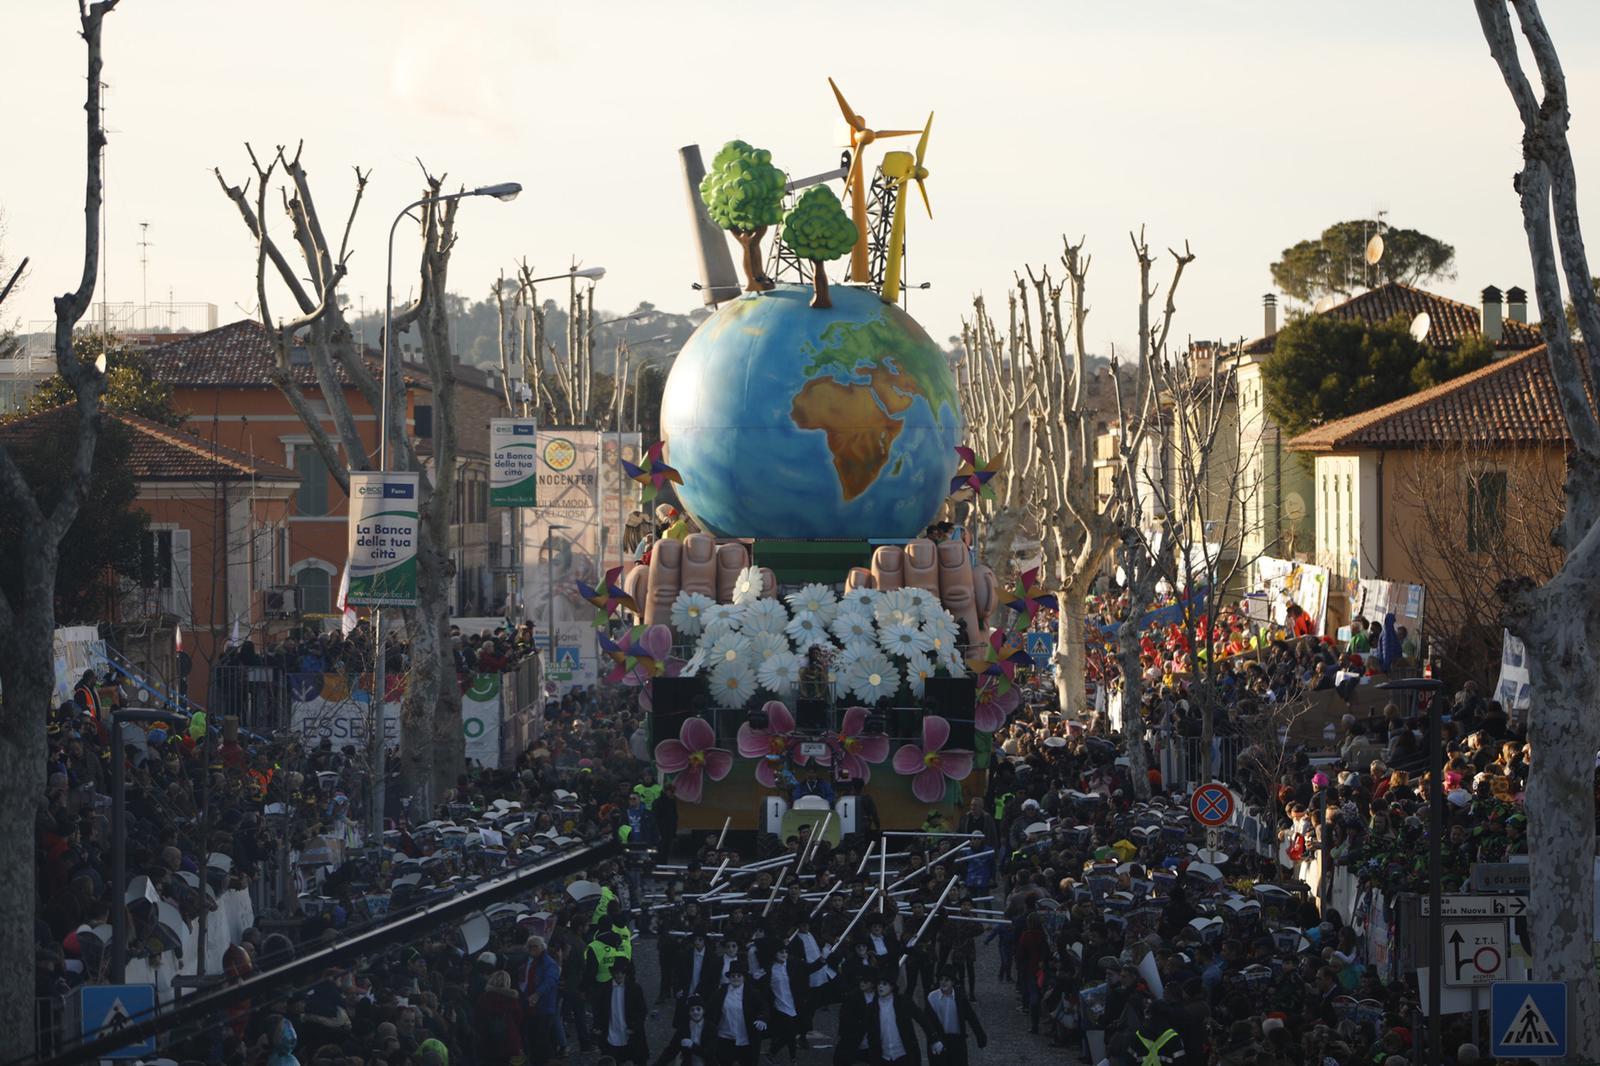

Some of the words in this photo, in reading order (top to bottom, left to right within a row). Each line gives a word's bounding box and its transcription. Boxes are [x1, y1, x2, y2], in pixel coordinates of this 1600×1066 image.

[494, 452, 504, 460] La
[507, 452, 533, 460] Banca
[494, 460, 516, 468] della
[539, 474, 594, 485] NOCENTER
[356, 524, 370, 535] La
[375, 524, 411, 535] Banca
[357, 535, 386, 547] della
[390, 537, 411, 547] tua
[370, 548, 396, 559] città
[303, 717, 396, 739] ESSEE
[1474, 936, 1499, 945] Z.T.L.
